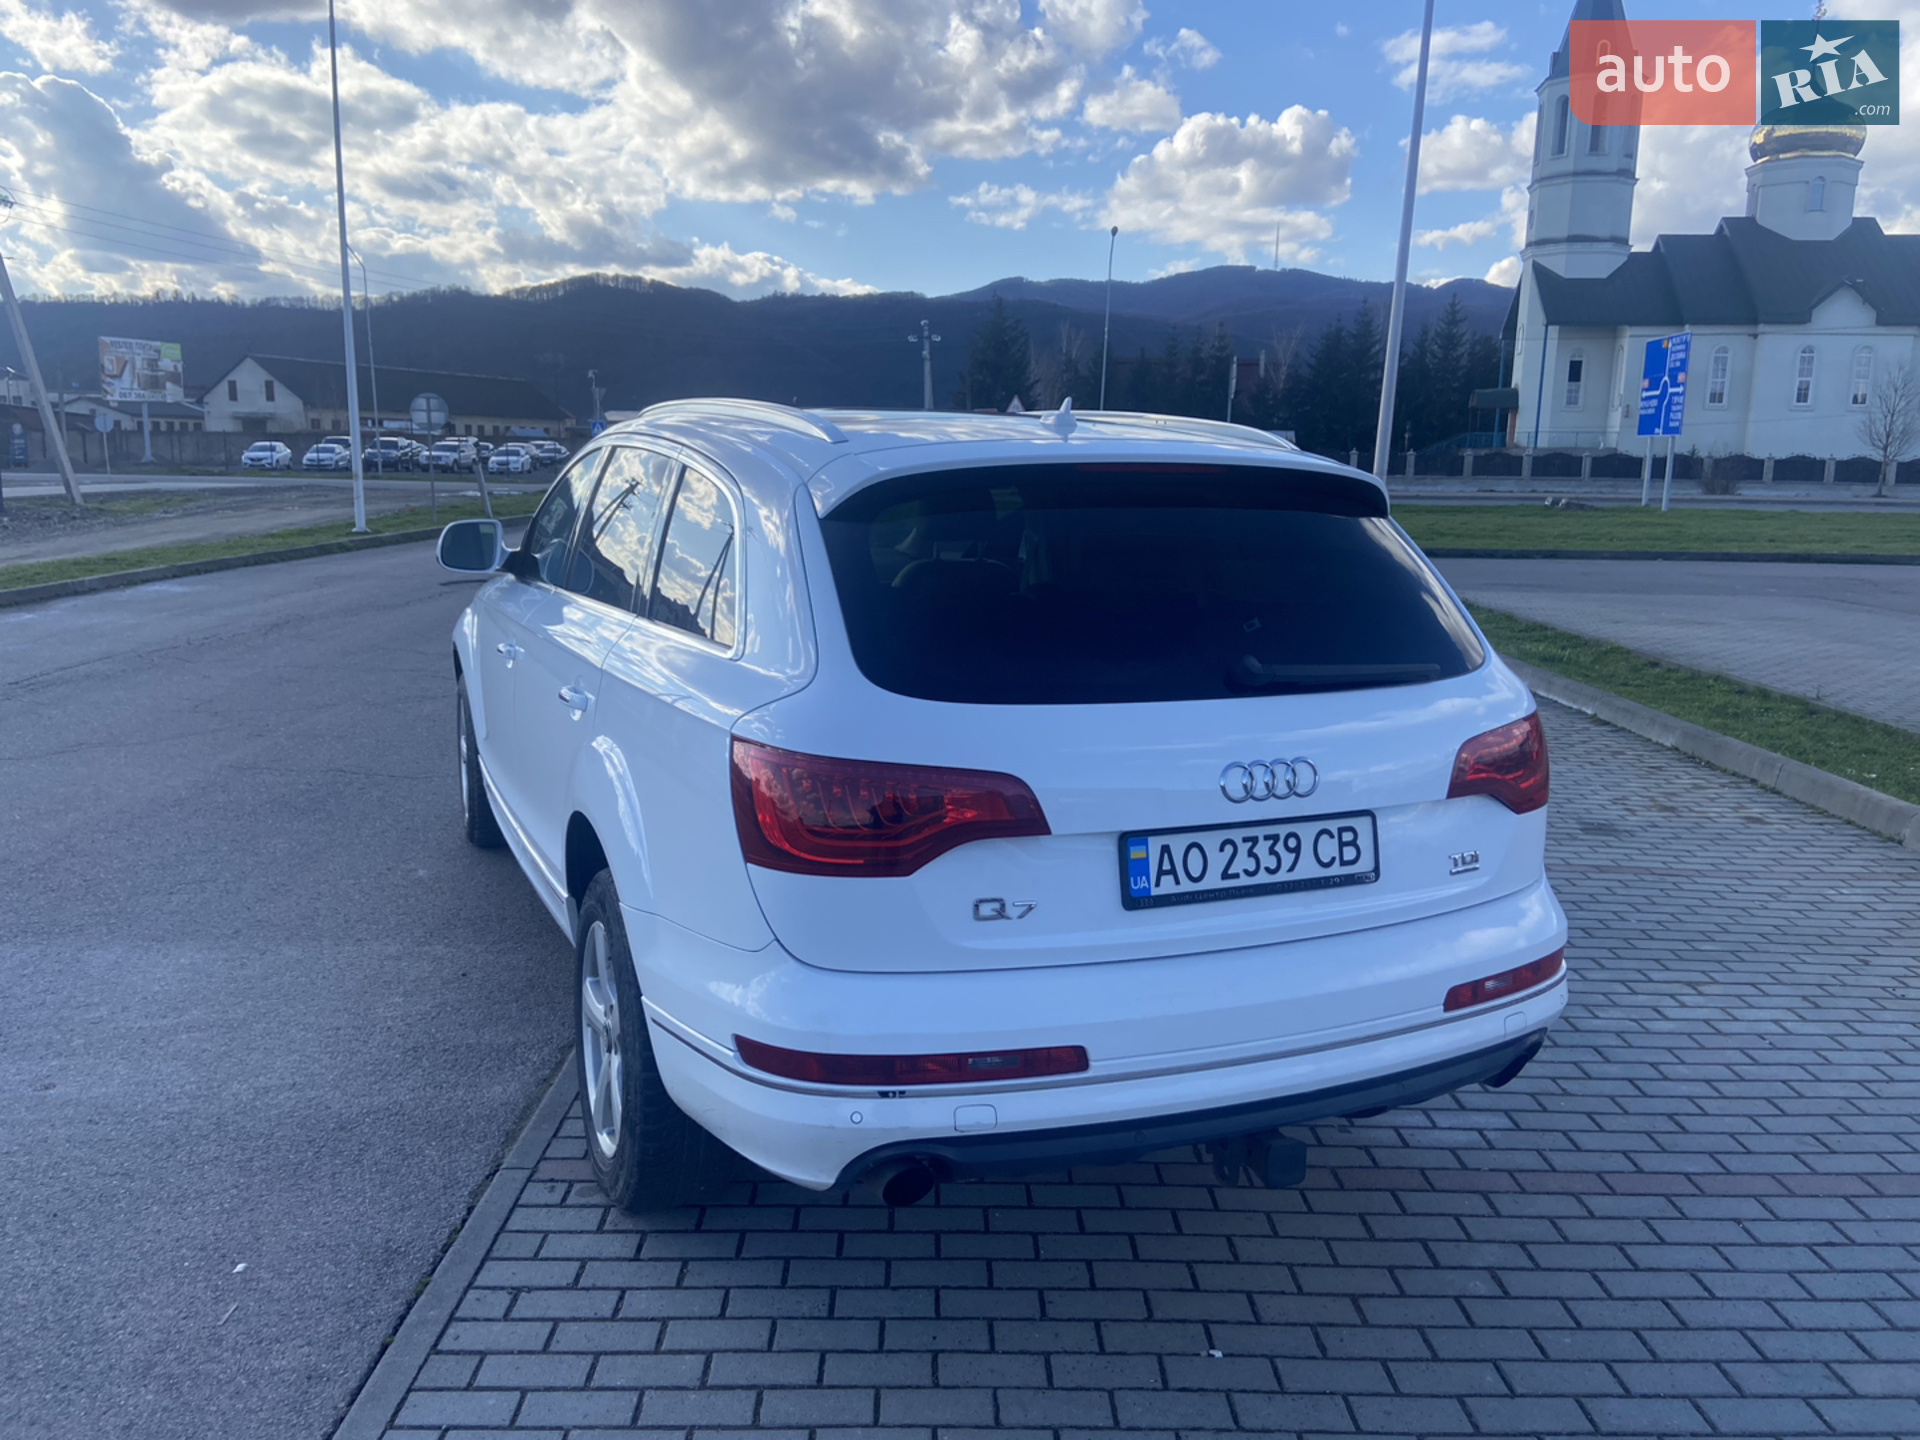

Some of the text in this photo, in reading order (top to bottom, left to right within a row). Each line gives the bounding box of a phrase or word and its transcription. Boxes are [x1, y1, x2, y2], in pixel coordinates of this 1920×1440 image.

[1154, 826, 1361, 888] AO 2339 CB
[1448, 850, 1480, 868] TDI
[1130, 875, 1149, 890] UA
[973, 897, 1037, 922] Q7
